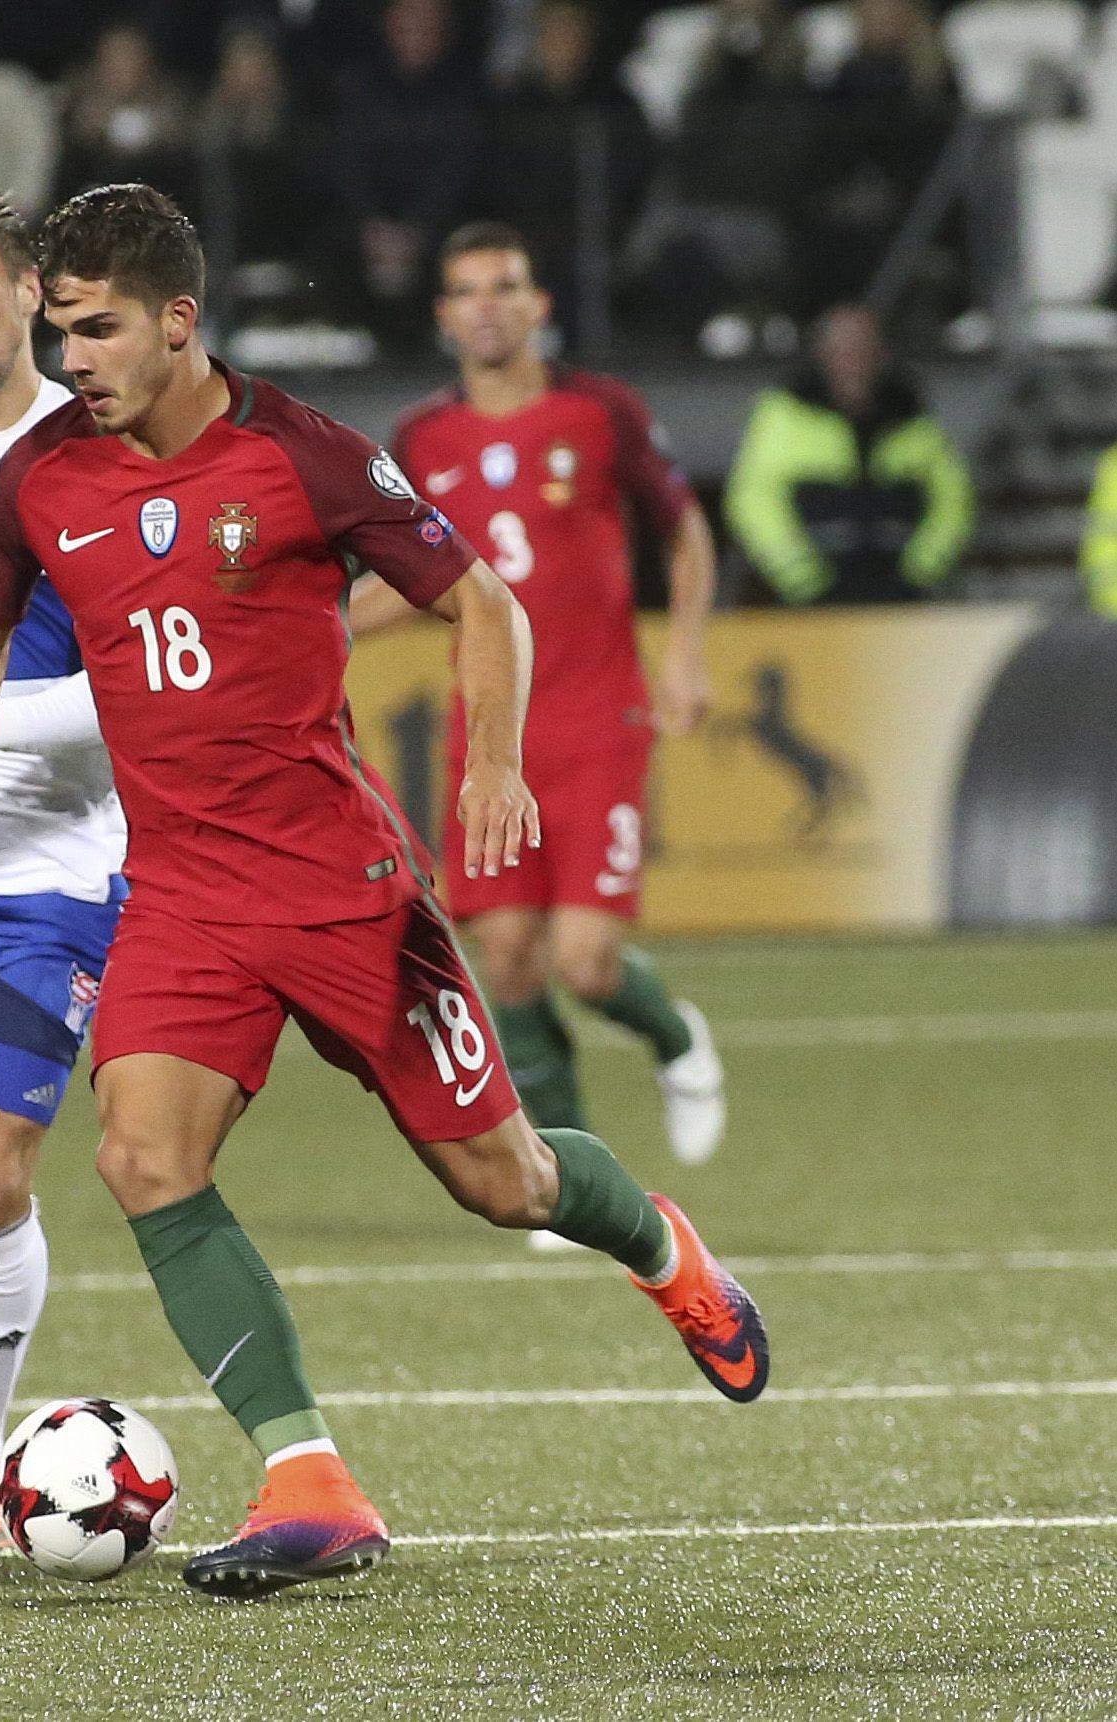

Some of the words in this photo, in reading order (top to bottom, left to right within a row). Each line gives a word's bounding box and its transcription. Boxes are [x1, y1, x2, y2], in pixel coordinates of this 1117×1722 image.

[486, 510, 534, 583] 3
[127, 605, 213, 692] 18
[605, 802, 641, 872] 3
[405, 988, 486, 1085] 18
